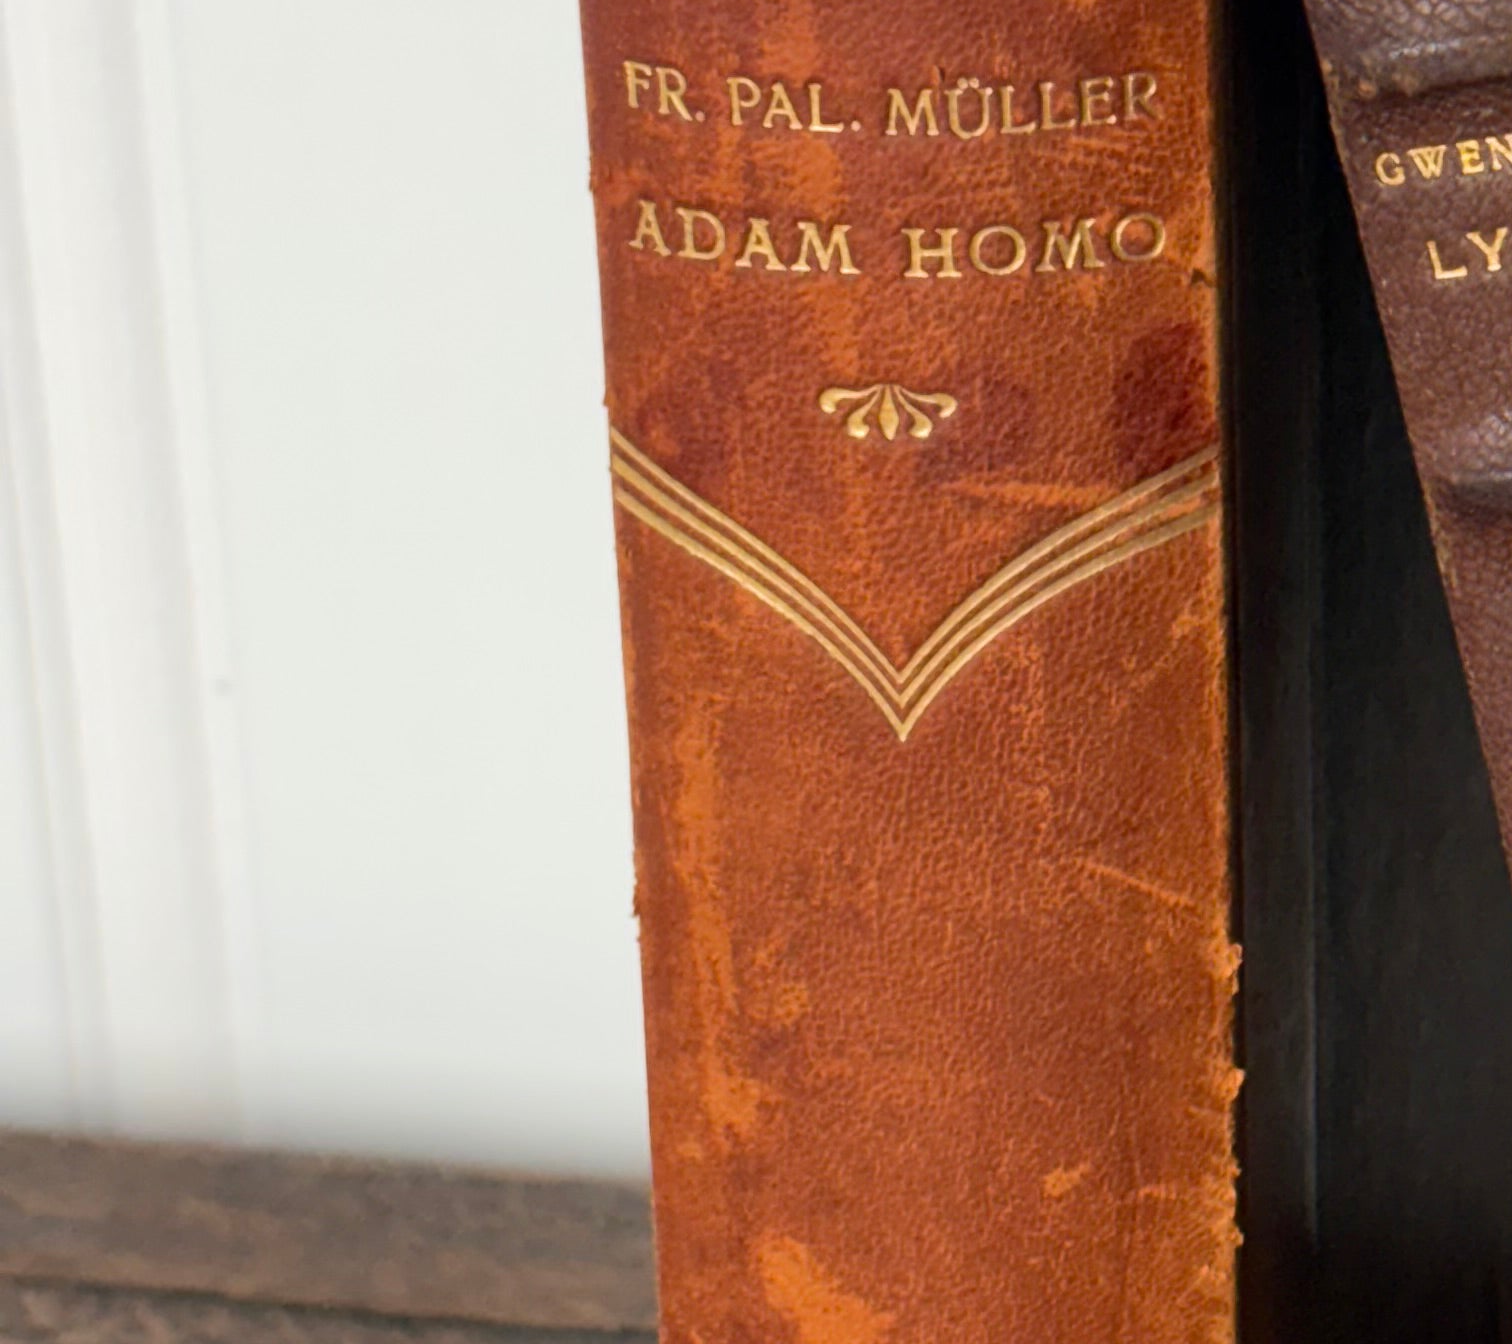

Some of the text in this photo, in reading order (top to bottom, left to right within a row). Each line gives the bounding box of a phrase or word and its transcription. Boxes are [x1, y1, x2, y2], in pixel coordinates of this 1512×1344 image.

[622, 60, 1167, 140] FR. PAL. MÜLLER
[628, 199, 1168, 279] ADAM HOMO
